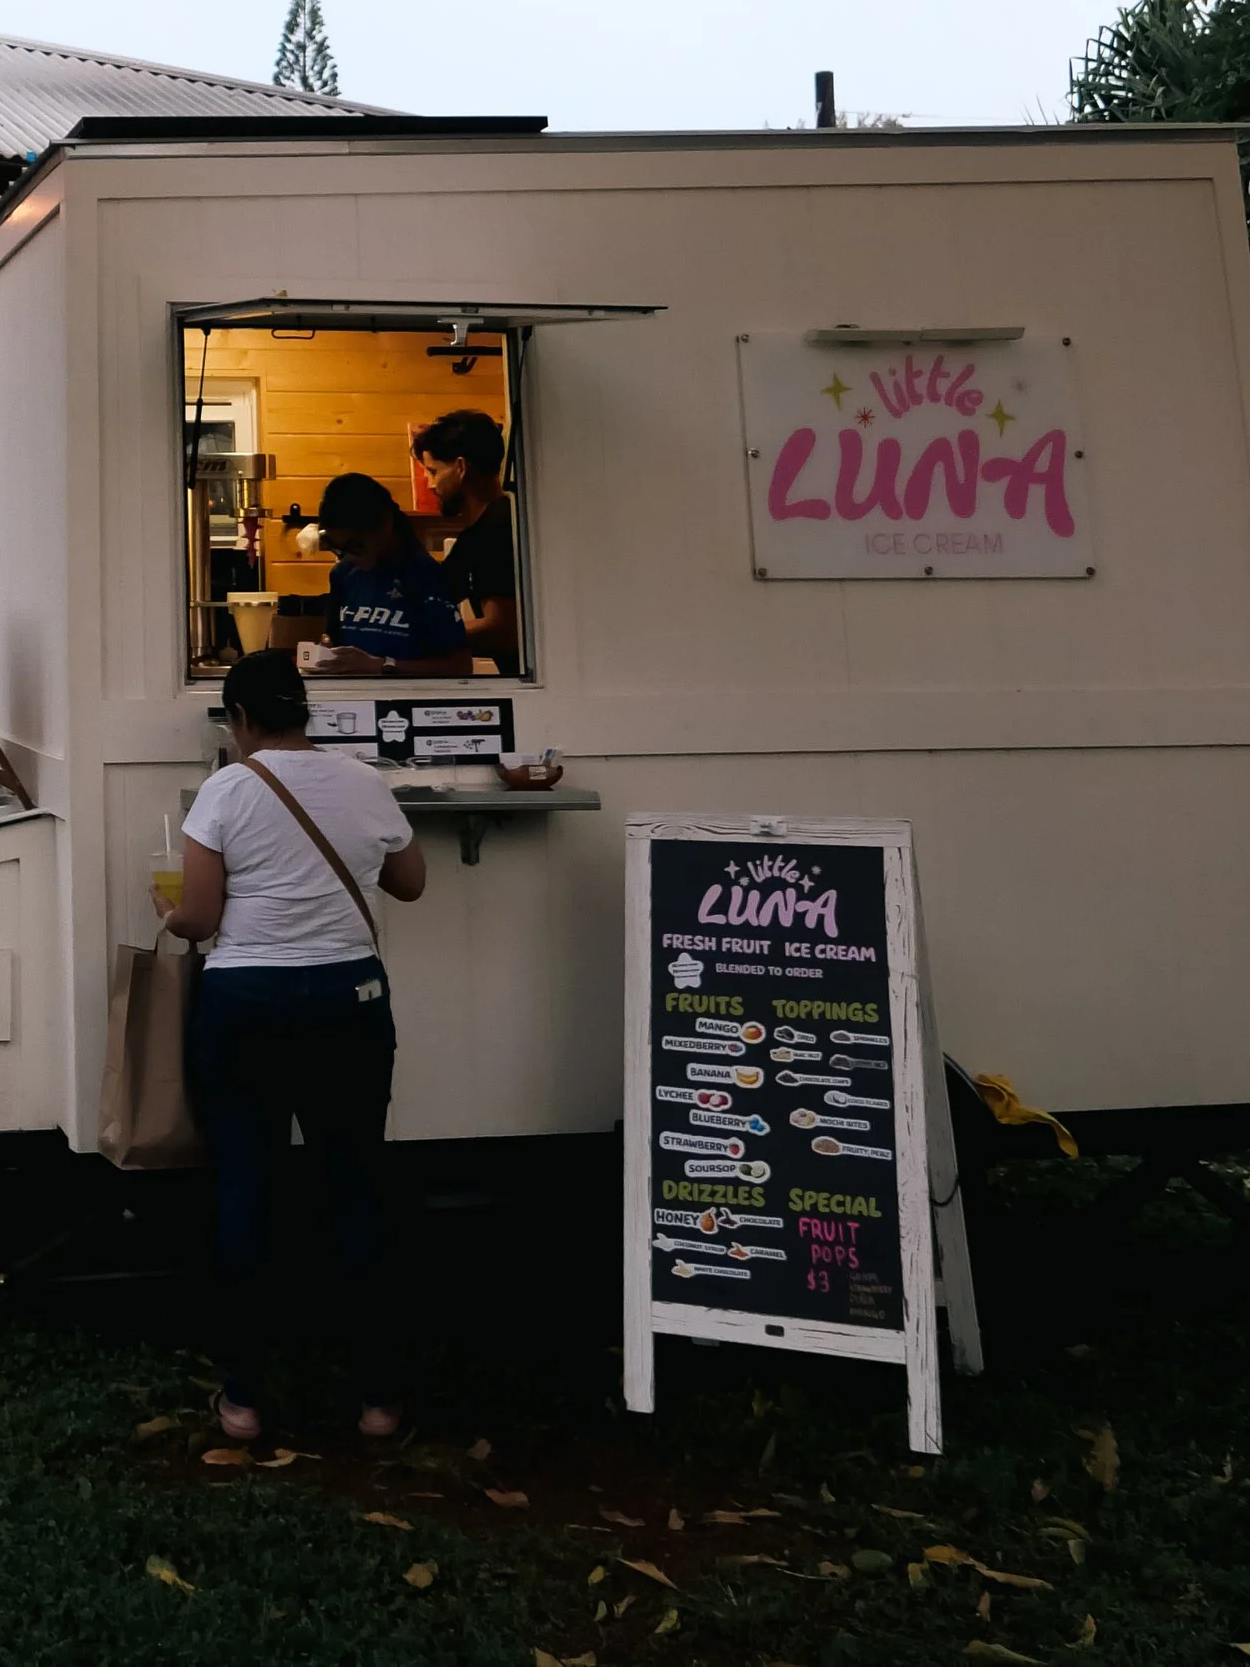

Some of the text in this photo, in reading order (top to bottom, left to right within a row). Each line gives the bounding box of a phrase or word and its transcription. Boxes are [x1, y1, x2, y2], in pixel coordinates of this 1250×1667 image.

[869, 354, 984, 418] little
[768, 427, 1075, 538] LUNA
[866, 533, 1004, 555] ICE CREAM
[747, 854, 800, 883] little
[698, 884, 839, 938] LUNA
[662, 934, 877, 962] FRESH FRUIT ICE CREAM
[715, 962, 766, 976] BLENDED
[768, 965, 782, 976] TO
[785, 966, 824, 978] ORDER
[665, 992, 745, 1016] FRUITS
[771, 999, 880, 1023] TOPPINGS
[698, 1021, 739, 1034] MANGO
[664, 1038, 728, 1052] MIXEDBERRY
[690, 1067, 731, 1079] BANANA
[658, 1089, 694, 1101] LYCHEE
[692, 1112, 747, 1128] BLUEBERRY
[663, 1135, 729, 1153] STRAWBERRY
[688, 1163, 736, 1173] SOURSOP
[662, 1180, 766, 1208] DRIZZLES
[788, 1187, 882, 1218] SPECIAL
[655, 1209, 700, 1226] HONEY
[798, 1217, 860, 1245] FRUIT
[810, 1243, 860, 1269] POPS
[807, 1268, 830, 1293] $3
